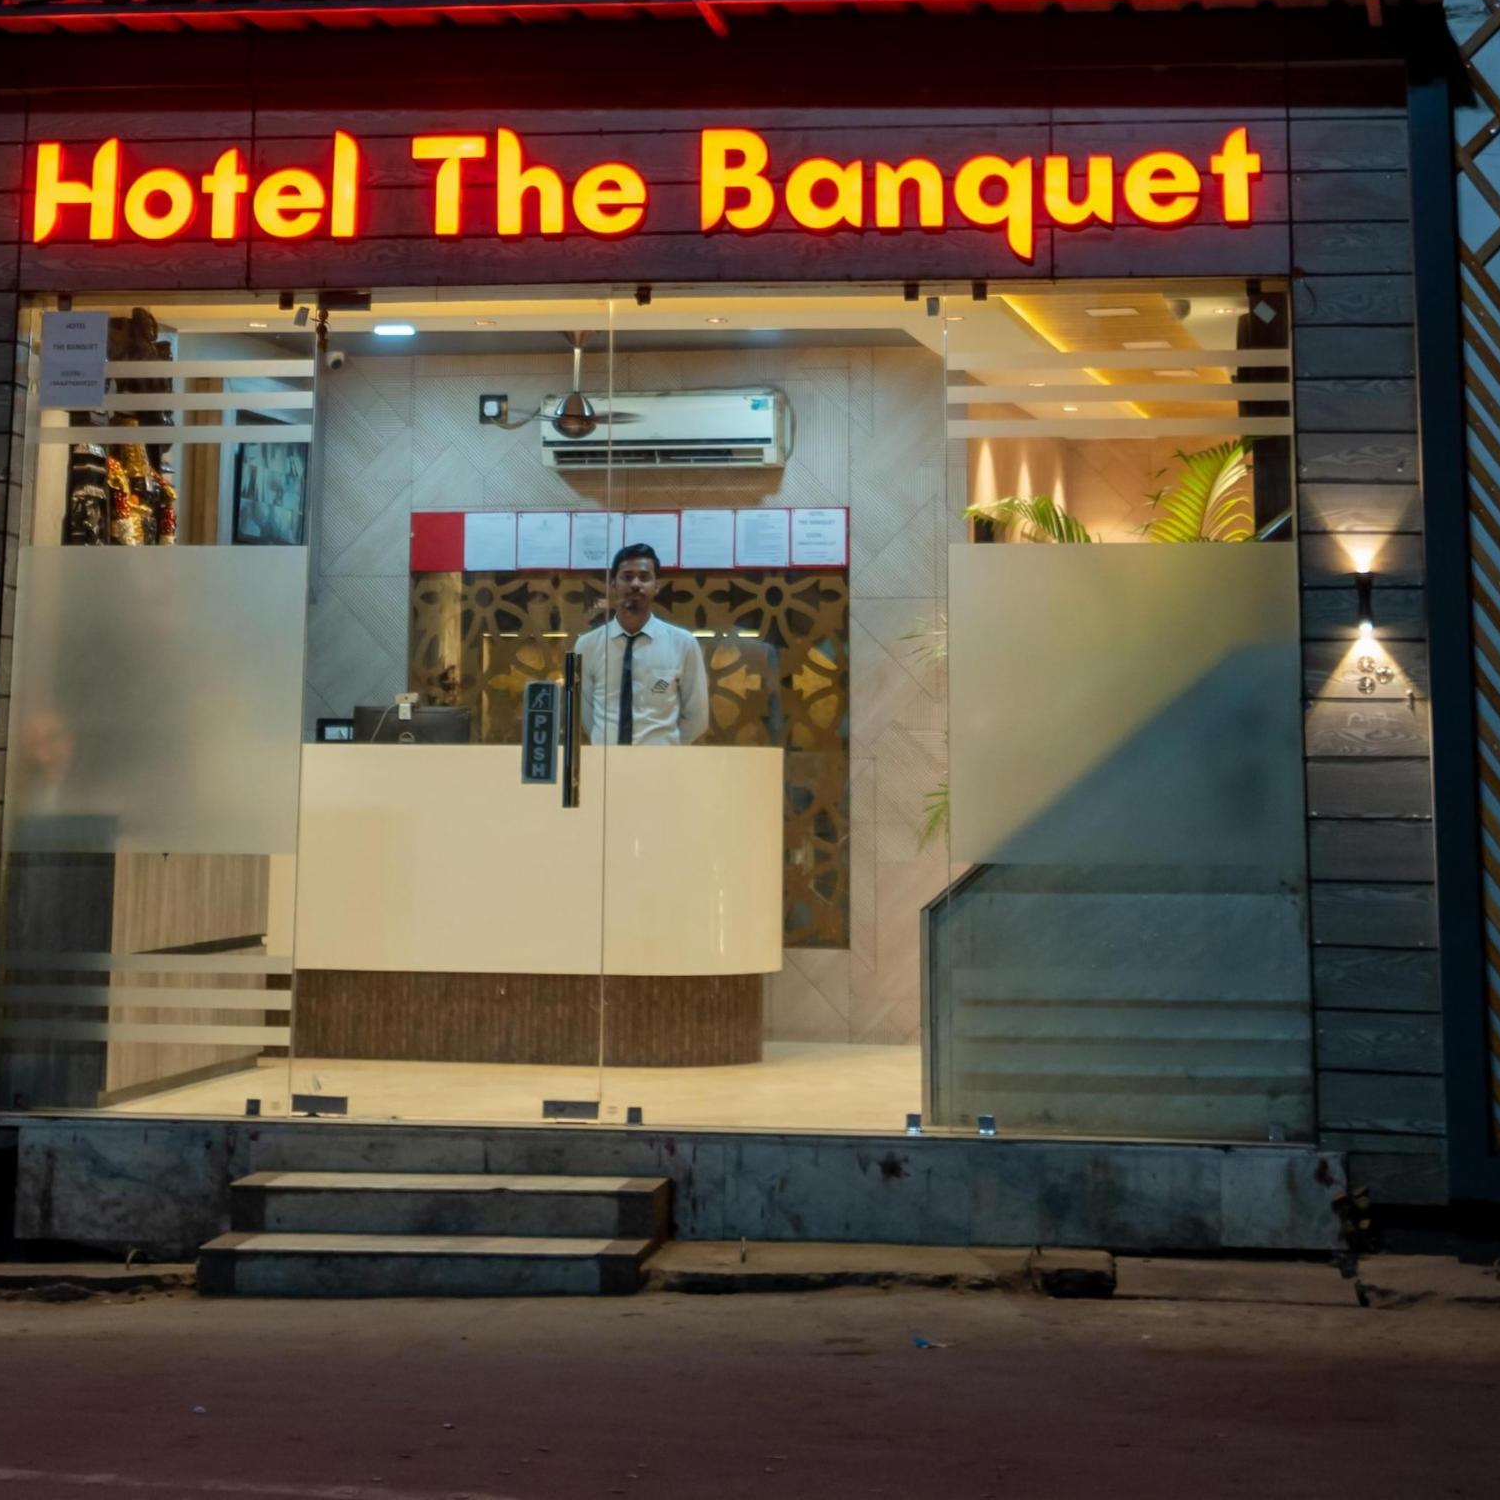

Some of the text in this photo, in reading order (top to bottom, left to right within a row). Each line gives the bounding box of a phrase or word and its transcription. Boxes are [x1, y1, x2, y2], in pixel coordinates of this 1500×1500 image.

[32, 126, 1262, 265] Hotel The Banquet
[531, 715, 547, 777] PUSH
